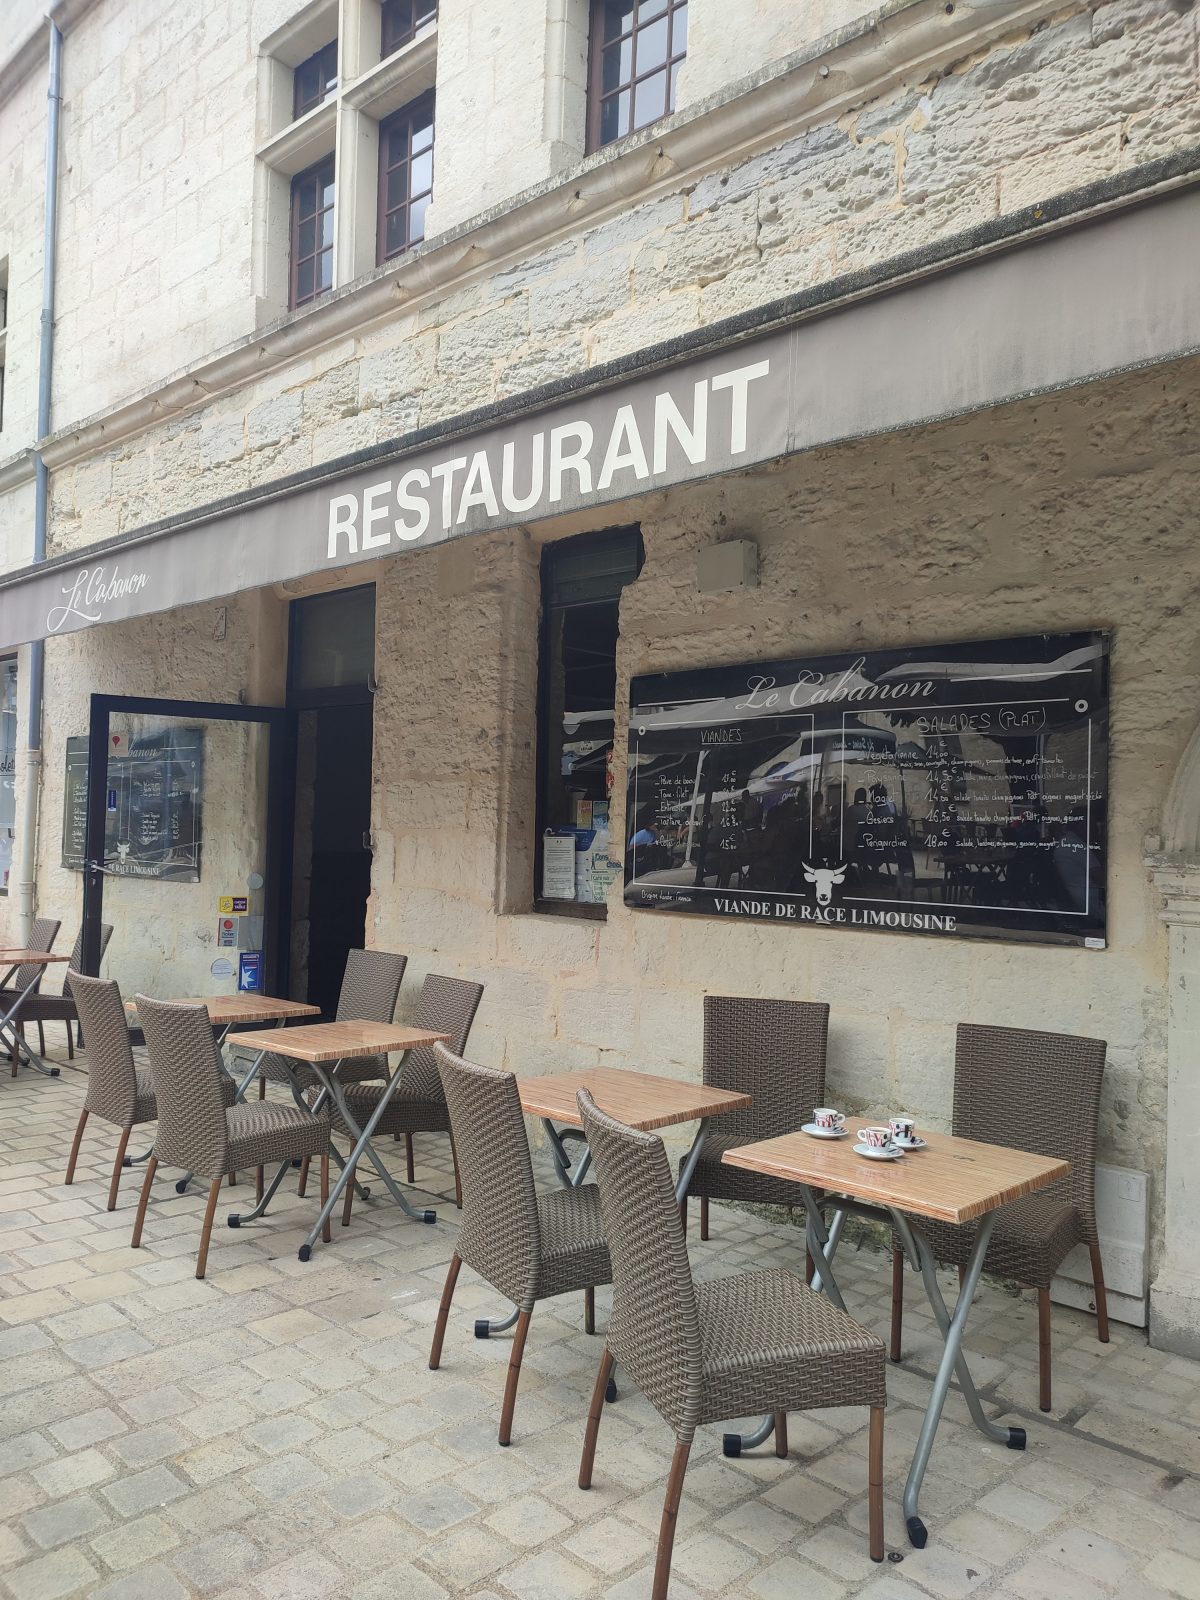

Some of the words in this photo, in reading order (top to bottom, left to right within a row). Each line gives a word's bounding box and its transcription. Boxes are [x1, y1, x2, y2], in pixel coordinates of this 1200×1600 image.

[326, 358, 770, 560] RESTAURANT
[46, 569, 102, 632] Le
[85, 566, 151, 606] Cabanon
[735, 674, 779, 710] Le
[789, 656, 937, 707] Cabanon
[700, 728, 742, 743] VIANDES
[916, 712, 991, 733] SALADES
[998, 706, 1046, 733] (PLAT)
[713, 898, 771, 916] VIANDE
[775, 903, 797, 918] DE
[801, 904, 847, 922] RACE
[851, 908, 957, 932] LIMOUSINE
